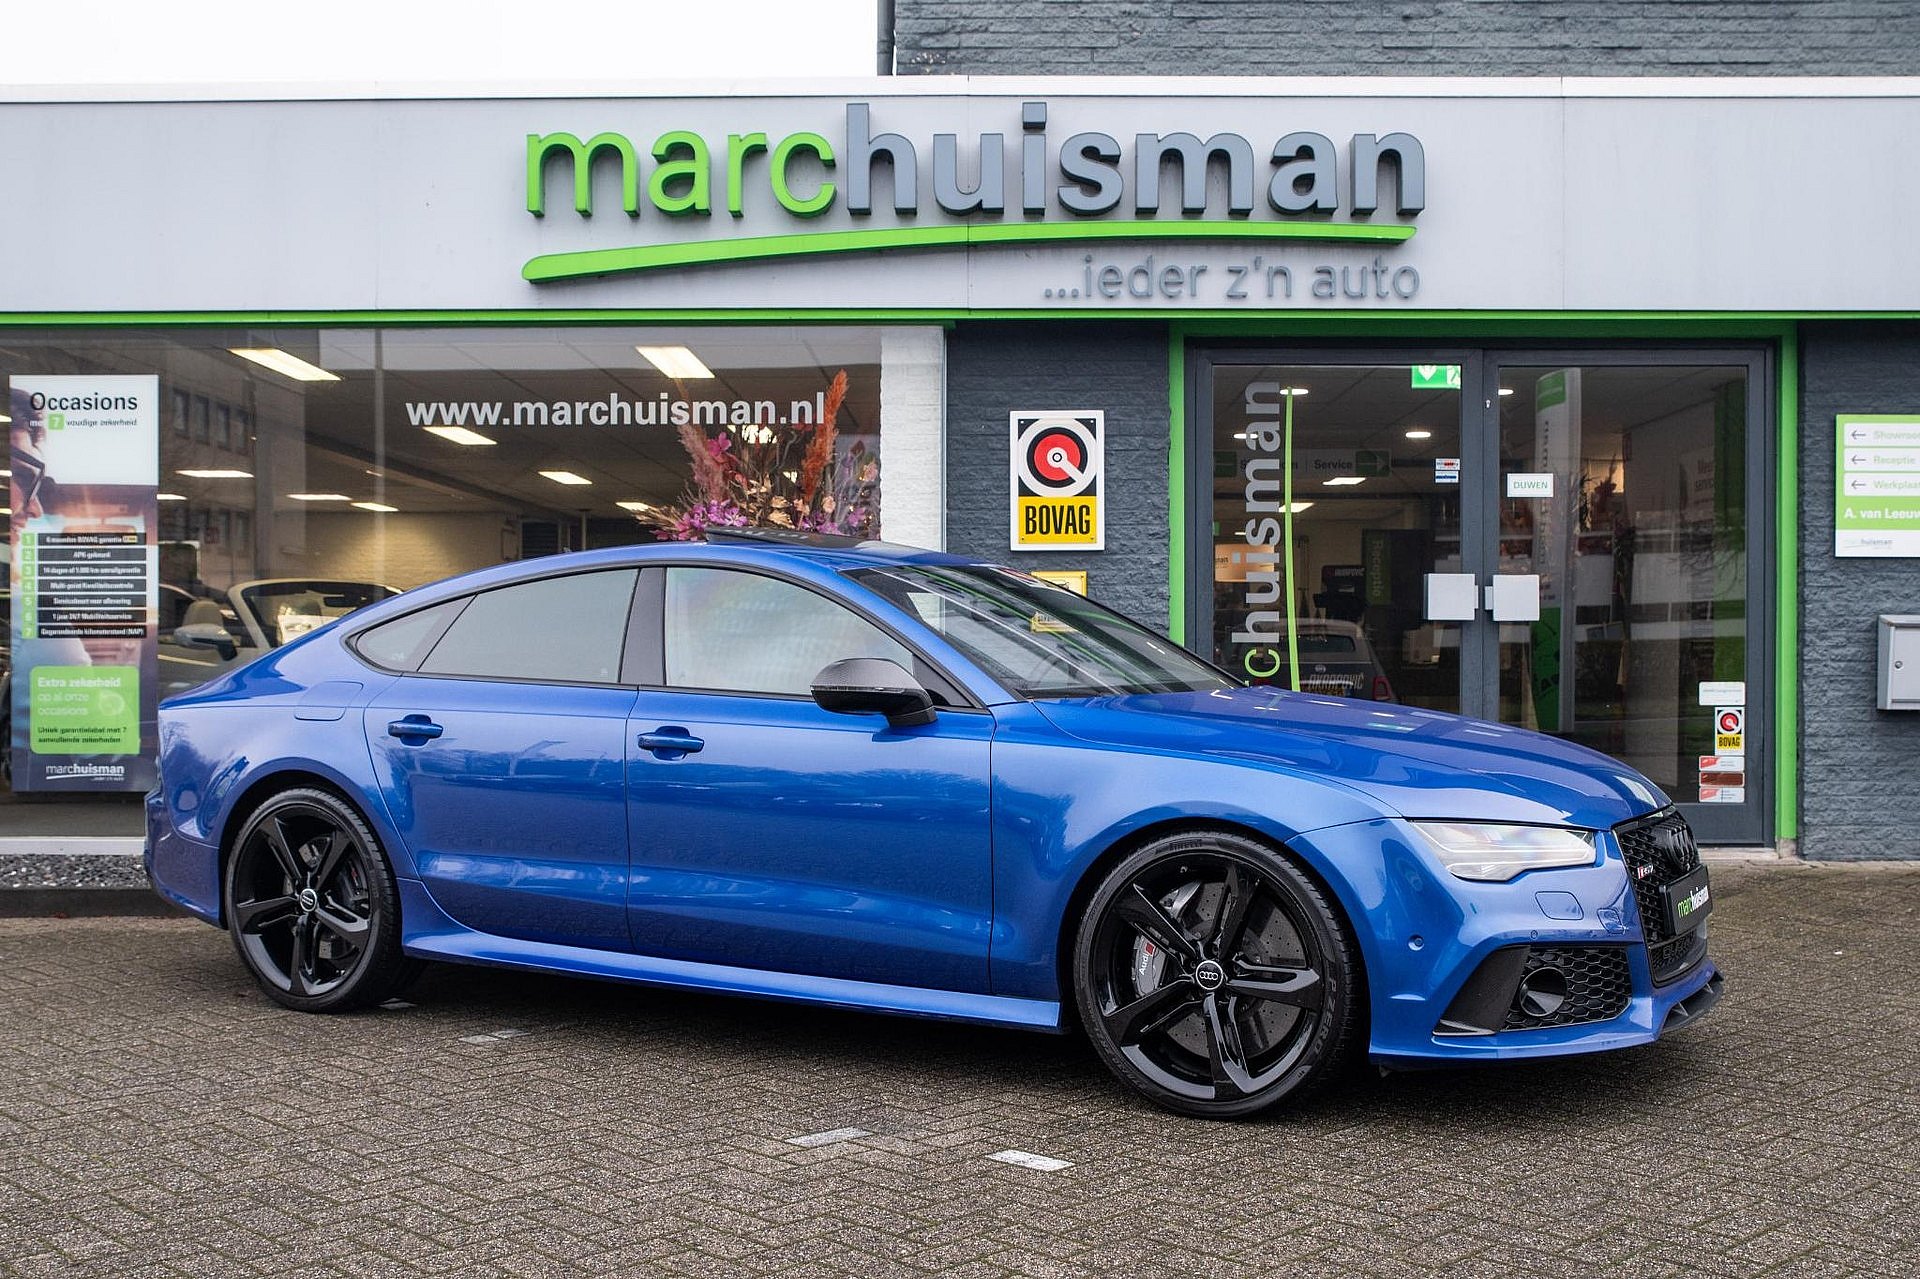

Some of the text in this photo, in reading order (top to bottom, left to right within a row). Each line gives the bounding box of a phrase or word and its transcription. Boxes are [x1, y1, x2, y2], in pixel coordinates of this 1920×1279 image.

[526, 102, 1426, 218] marchuisman
[1227, 256, 1293, 300] z'n
[1313, 264, 1420, 300] auto
[30, 391, 138, 411] Occasions
[405, 392, 825, 426] www.marchuisman.nl
[52, 416, 60, 428] 7
[67, 418, 98, 428] voudige
[100, 418, 138, 427] zekerheid
[1313, 459, 1353, 470] Service
[1873, 456, 1917, 465] Receptie
[1024, 505, 1091, 535] BOVAG
[1843, 507, 1857, 519] A.
[1860, 511, 1881, 519] van
[1231, 381, 1281, 686] chuisman
[38, 676, 121, 688] Extra zekerheid
[1718, 736, 1741, 748] BOVAG
[45, 763, 125, 775] marchuisman
[1138, 953, 1150, 976] Audi
